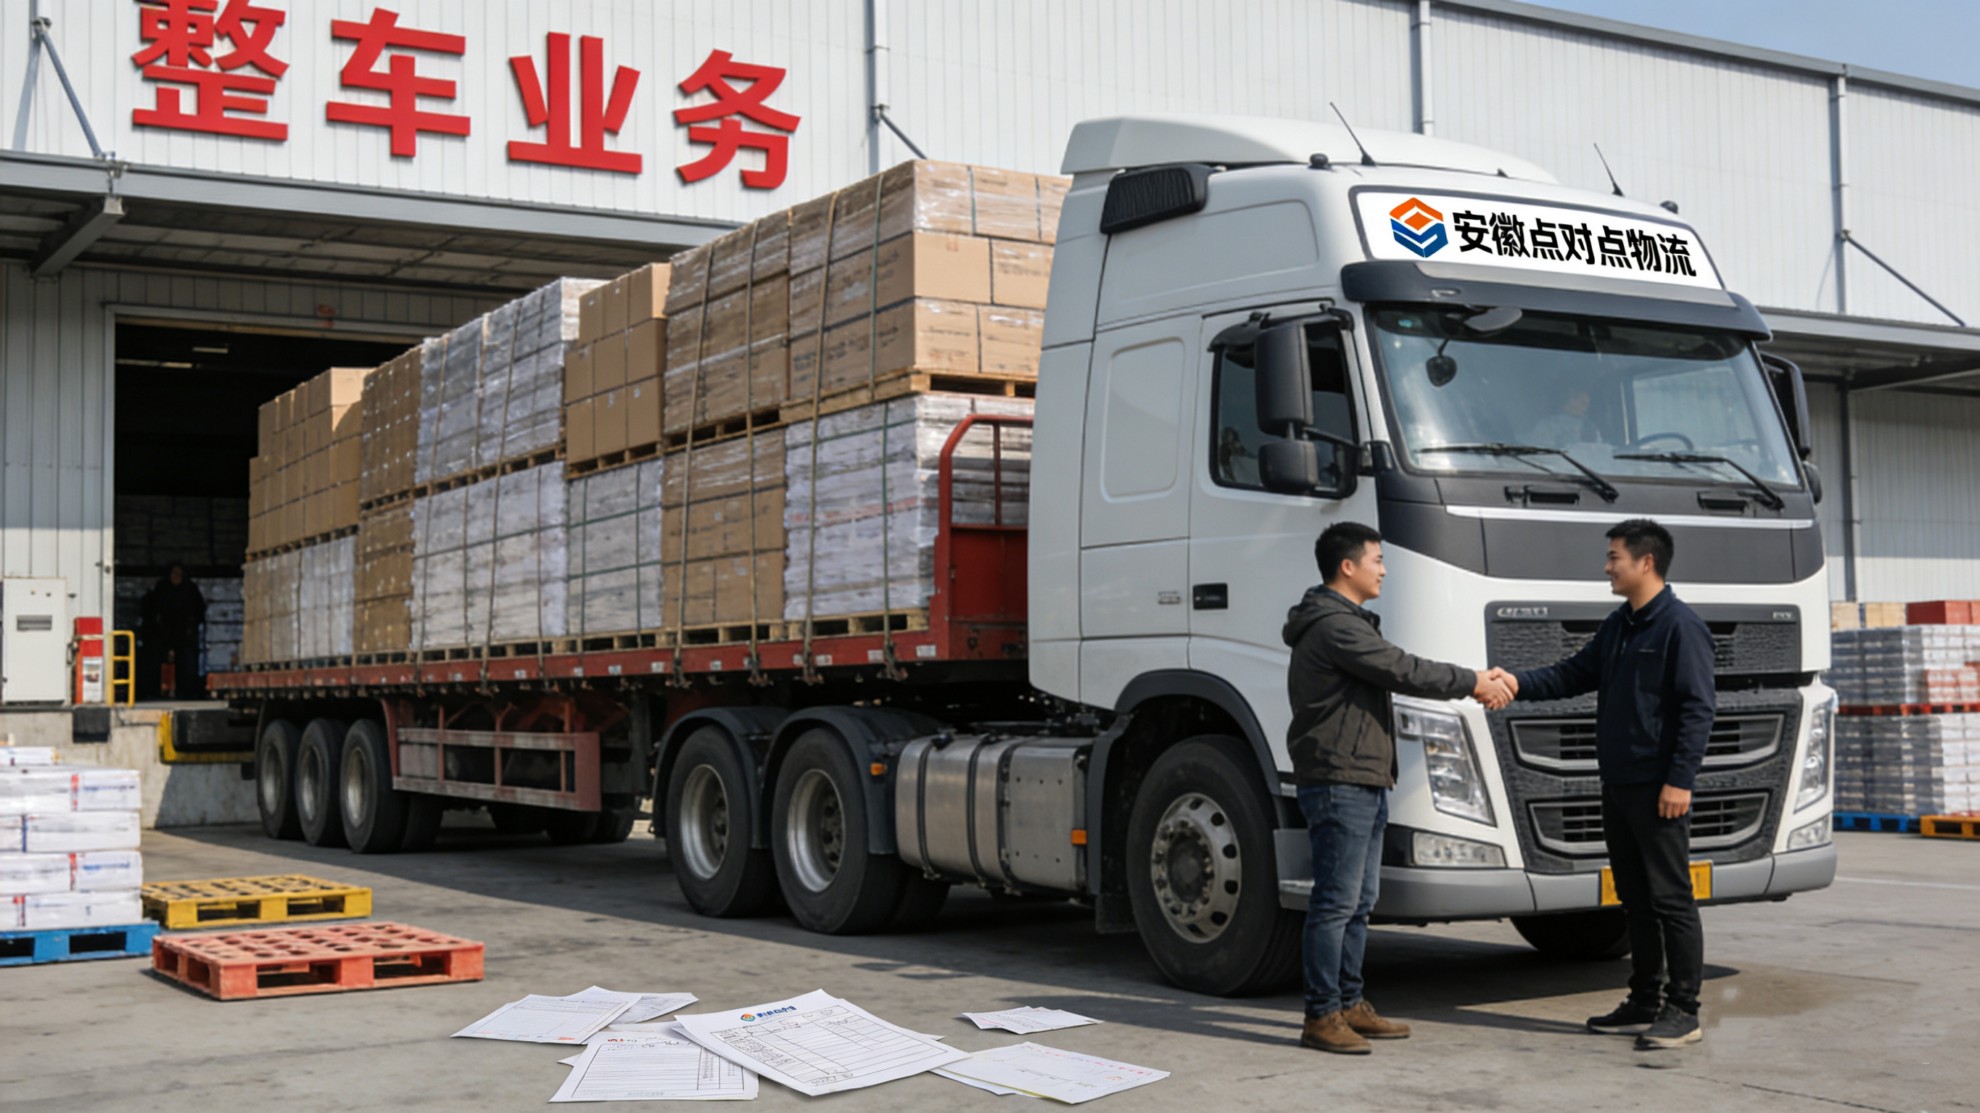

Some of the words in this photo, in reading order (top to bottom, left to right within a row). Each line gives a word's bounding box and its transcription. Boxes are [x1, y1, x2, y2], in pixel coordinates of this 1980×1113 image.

[132, 0, 801, 190] 整车业务
[1453, 210, 1697, 277] 安徽点对点物流
